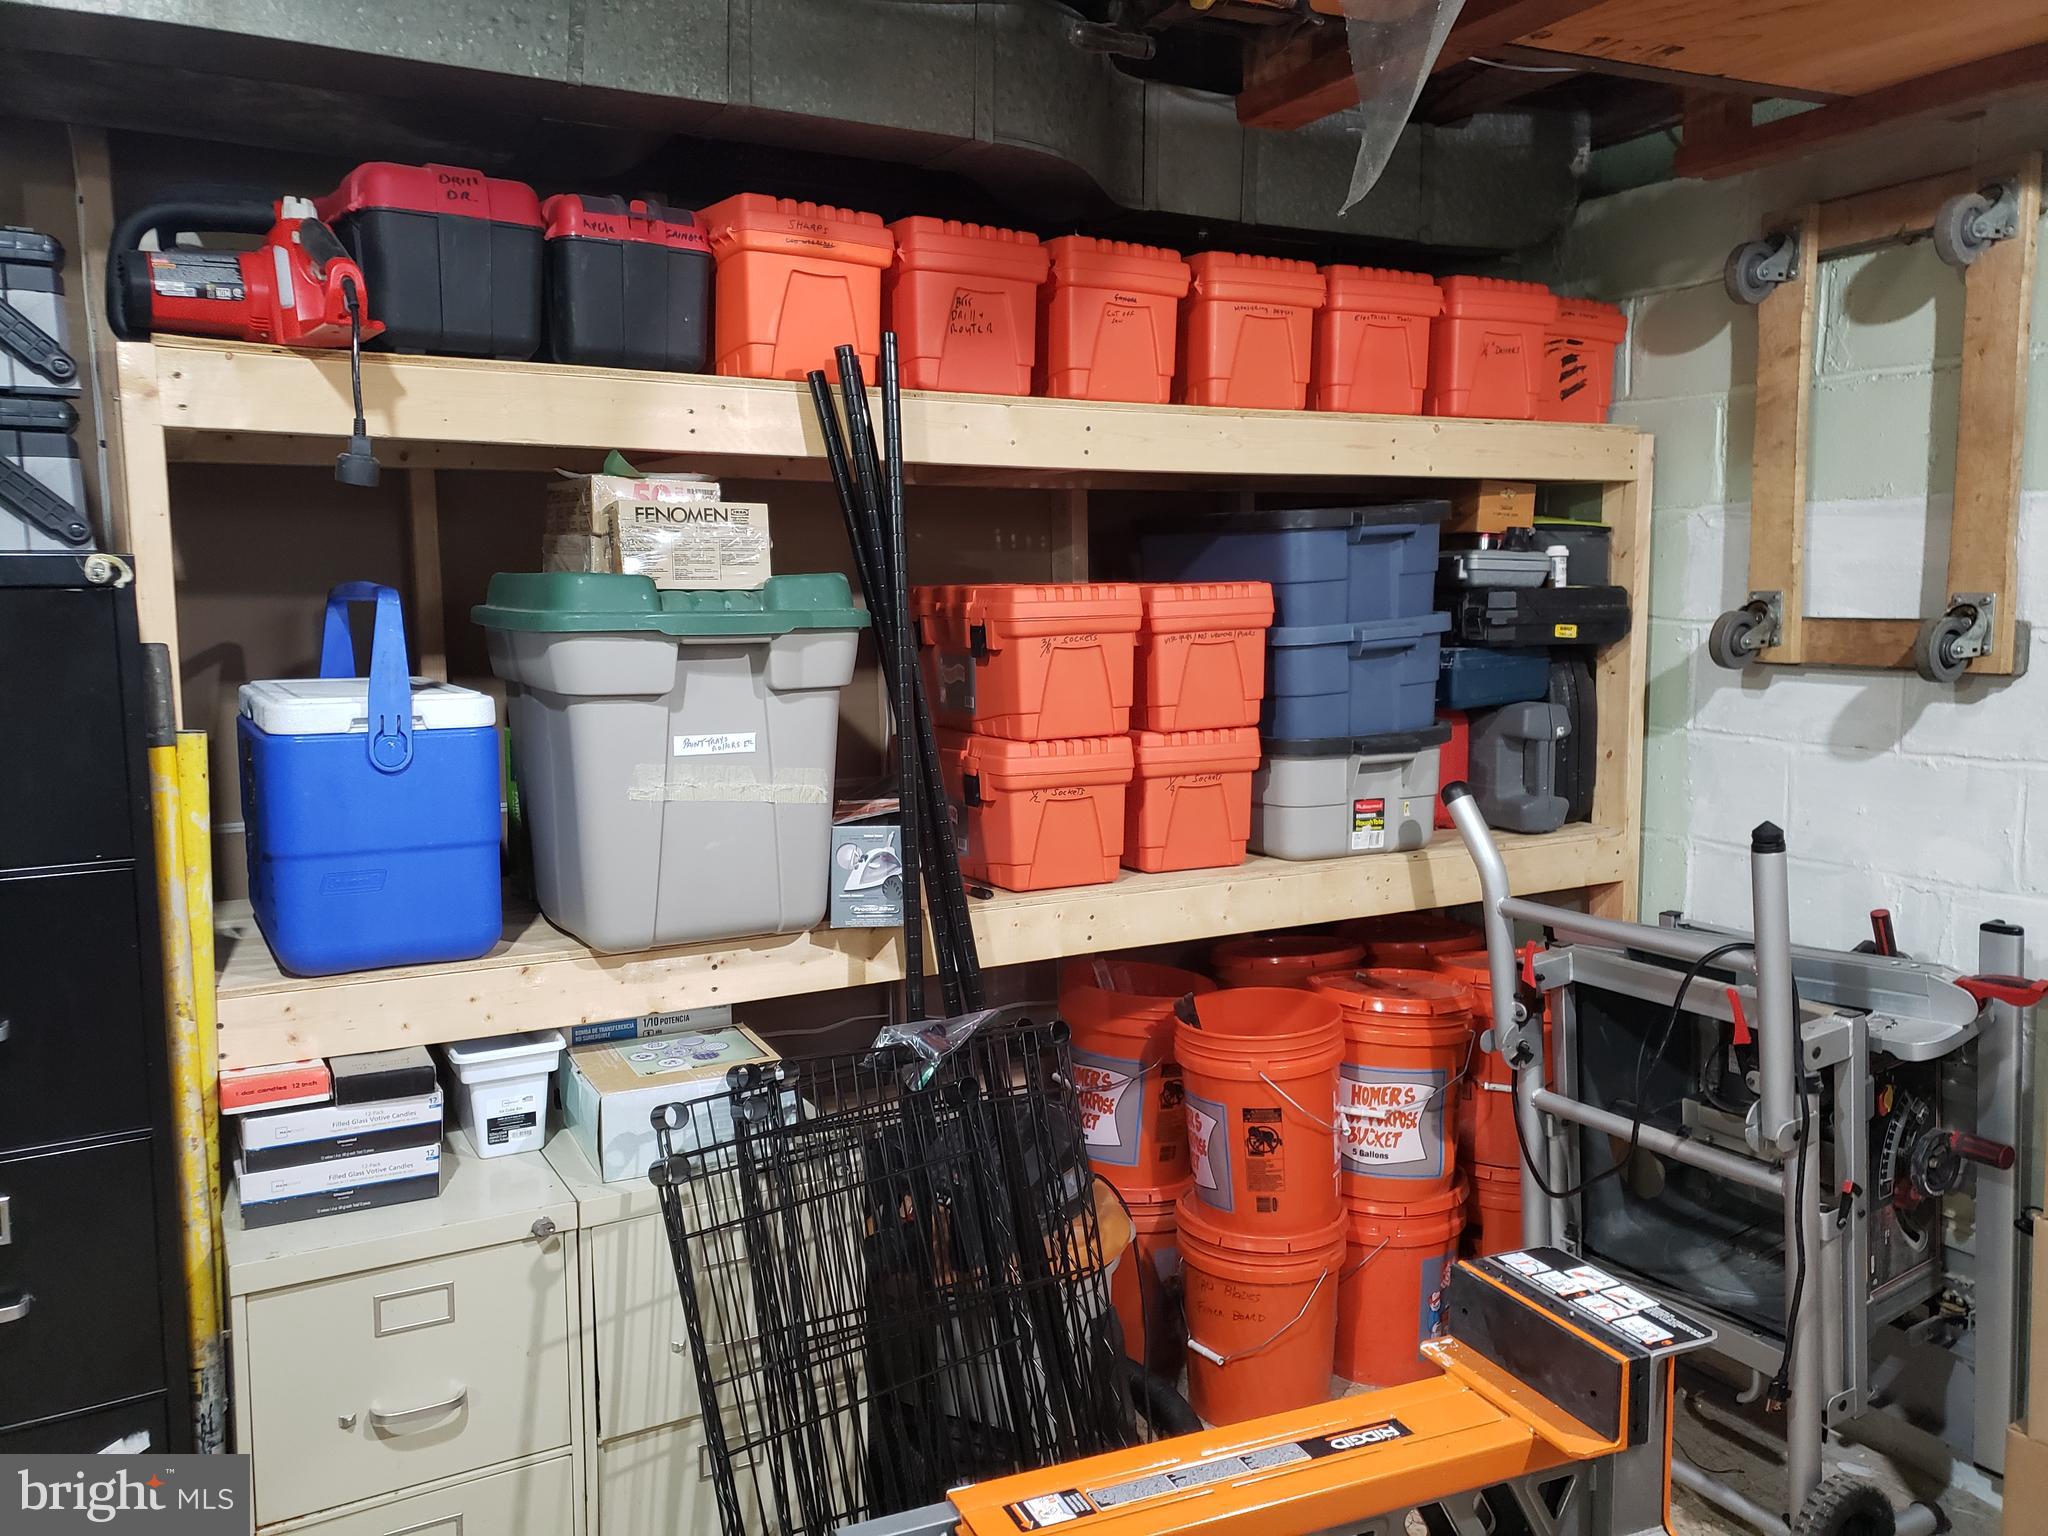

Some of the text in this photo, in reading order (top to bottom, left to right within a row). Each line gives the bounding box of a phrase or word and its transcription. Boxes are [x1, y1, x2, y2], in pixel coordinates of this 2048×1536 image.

[634, 506, 728, 523] FENOMEN
[642, 1014, 690, 1028] 1/10 POTENCIA
[257, 1084, 288, 1094] candles
[1350, 1083, 1417, 1108] HOMER'S
[428, 1096, 439, 1104] 12
[331, 1119, 350, 1129] Filled
[351, 1117, 369, 1126] Glass
[369, 1114, 391, 1123] Votive
[391, 1110, 417, 1119] Candles
[1347, 1126, 1403, 1149] BUCKET
[426, 1149, 435, 1157] 12
[1352, 1147, 1390, 1160] 5 Gallons
[328, 1172, 347, 1182] Filled
[347, 1169, 366, 1178] Glass
[365, 1166, 387, 1175] Votive
[388, 1162, 414, 1171] Candles
[1330, 1425, 1401, 1450] RIDGID
